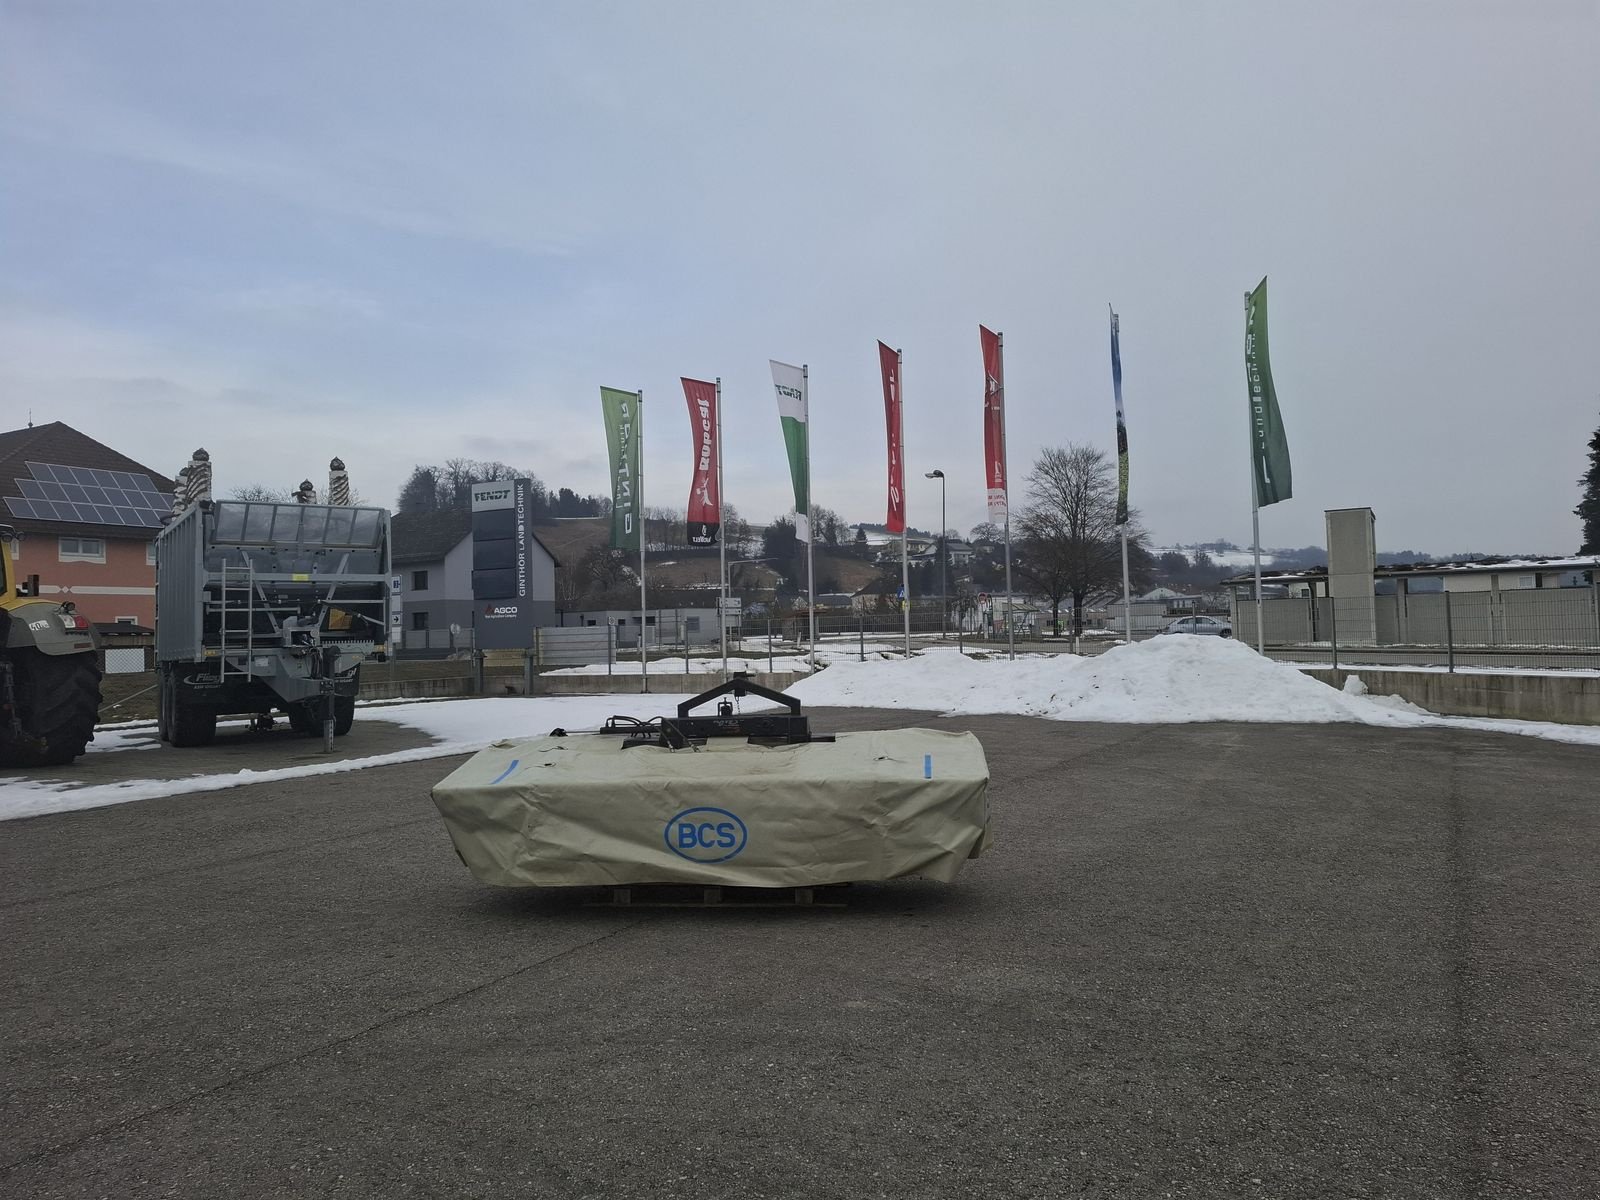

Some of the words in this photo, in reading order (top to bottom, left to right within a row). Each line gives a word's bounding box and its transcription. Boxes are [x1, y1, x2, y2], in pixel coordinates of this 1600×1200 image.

[474, 489, 511, 502] FENDT
[517, 484, 525, 551] LANDTECHNIK
[494, 606, 518, 614] AGCO
[196, 672, 222, 684] Flieg
[678, 822, 736, 849] BCS
